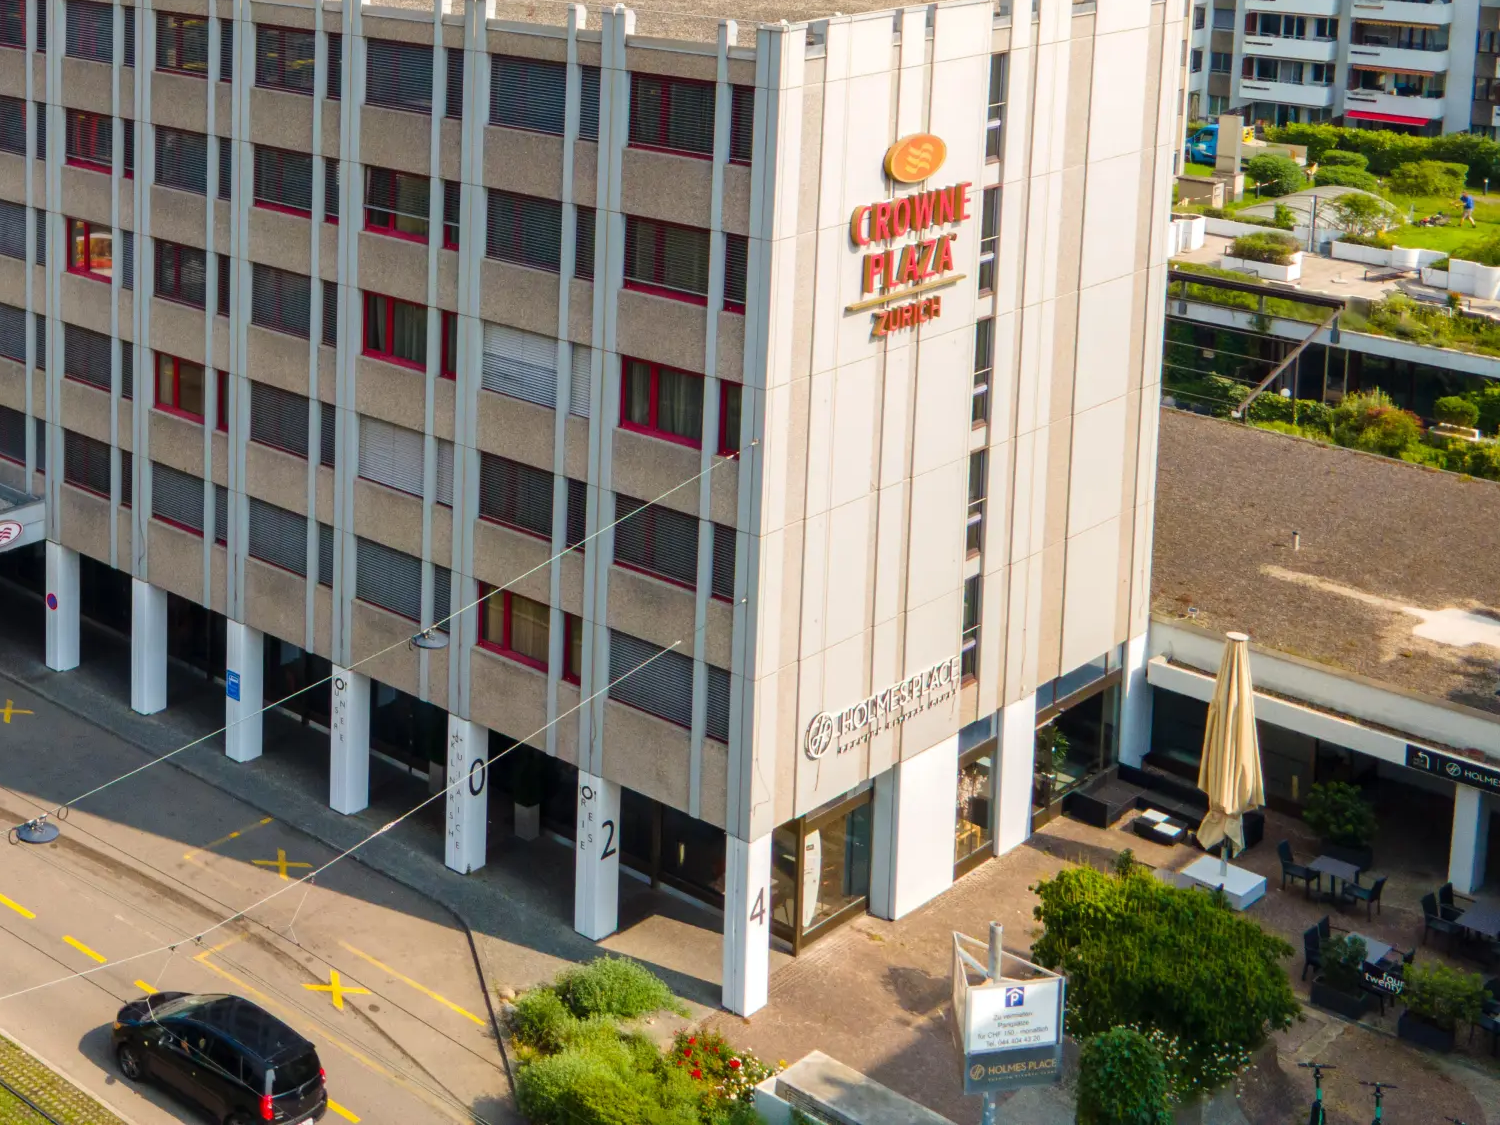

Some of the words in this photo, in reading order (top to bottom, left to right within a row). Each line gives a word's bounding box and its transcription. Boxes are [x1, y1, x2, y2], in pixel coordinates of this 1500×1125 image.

[851, 181, 972, 246] CROWNE
[864, 233, 955, 294] PLAZA
[872, 295, 941, 337] ZURICH
[841, 682, 909, 735] HOLMES
[912, 656, 960, 701] PLACE
[1463, 769, 1500, 787] HOLME
[600, 819, 616, 861] 2
[749, 886, 766, 925] 4
[988, 1062, 1026, 1075] HOLMES
[1028, 1059, 1057, 1070] PLACE
